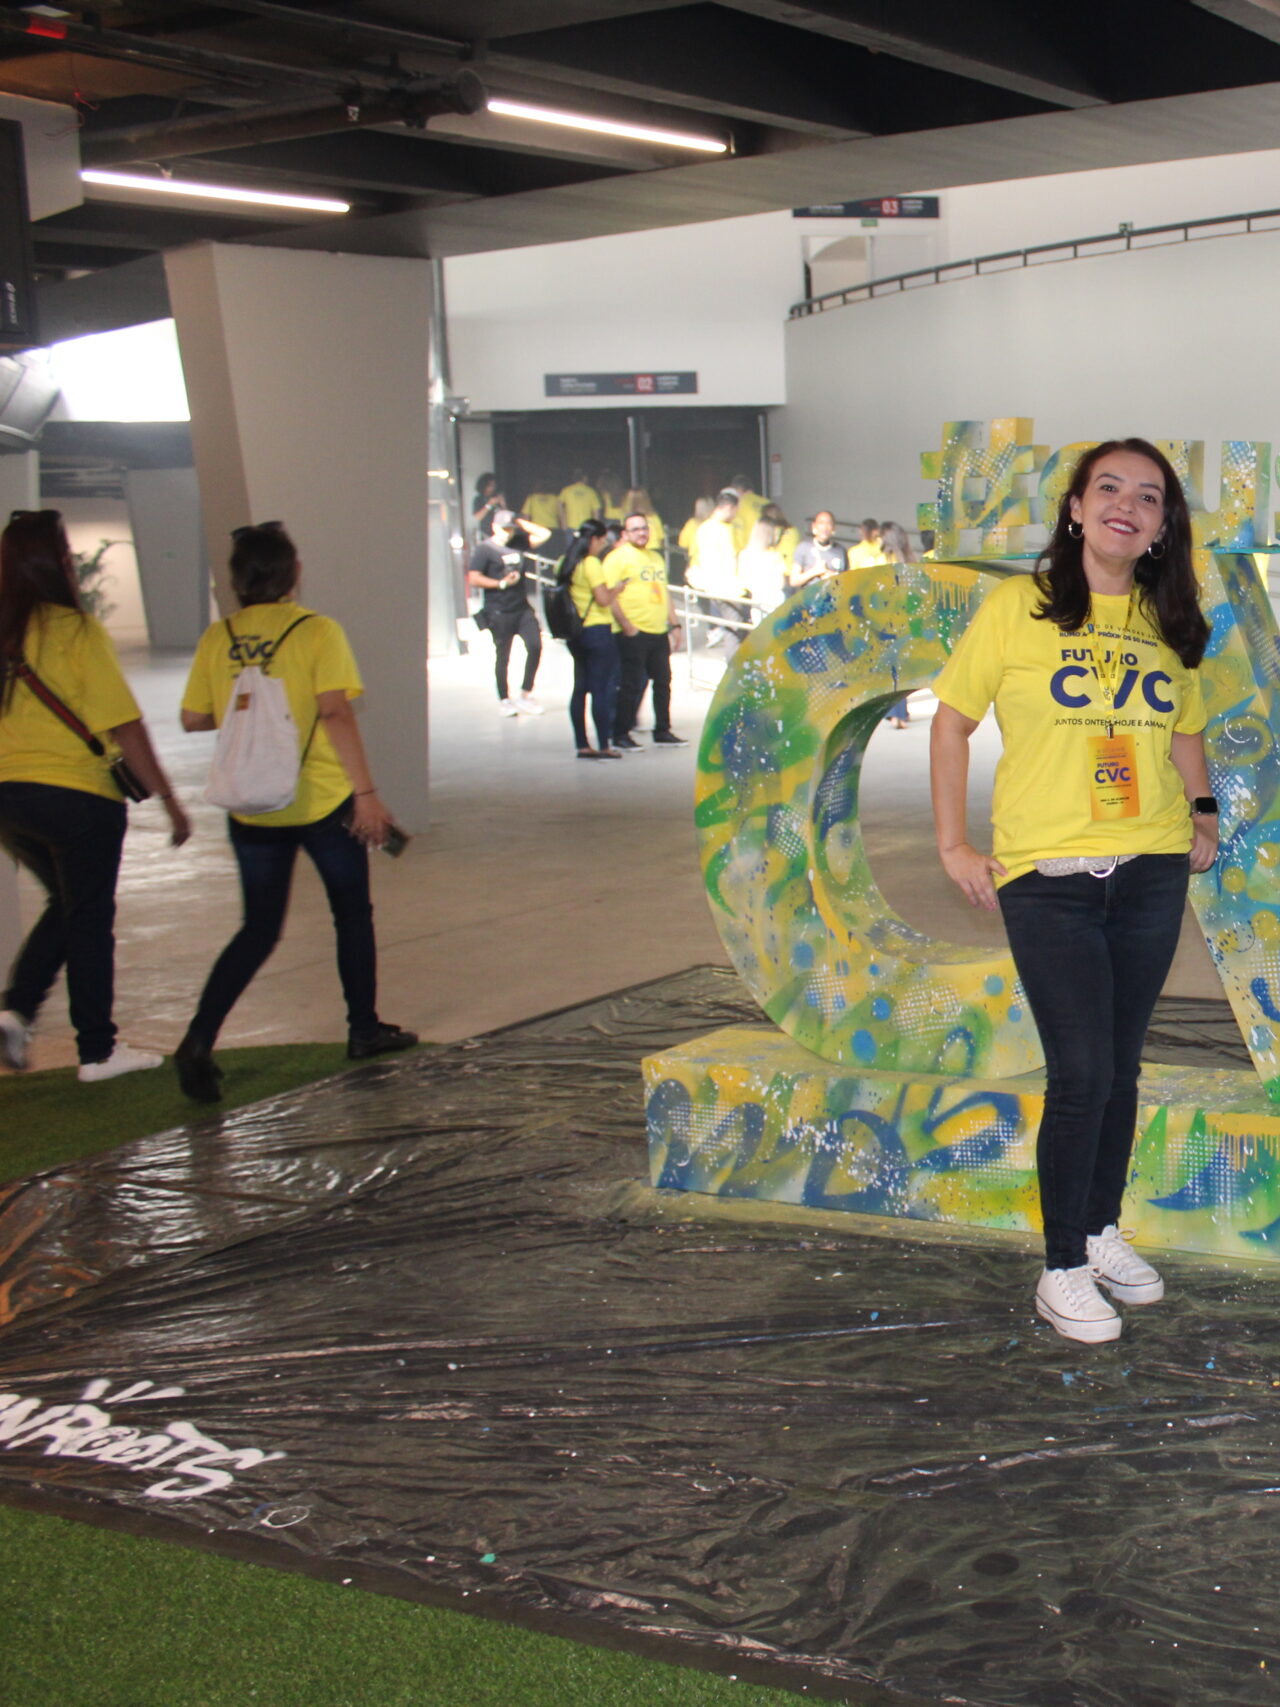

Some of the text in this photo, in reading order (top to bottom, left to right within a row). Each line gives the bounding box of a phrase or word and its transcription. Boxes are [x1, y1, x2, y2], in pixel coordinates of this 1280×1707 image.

[882, 200, 899, 215] 03
[229, 640, 273, 660] CVC
[1050, 665, 1175, 713] CVC
[1054, 718, 1083, 726] JUNTOS
[1095, 767, 1131, 783] CVC
